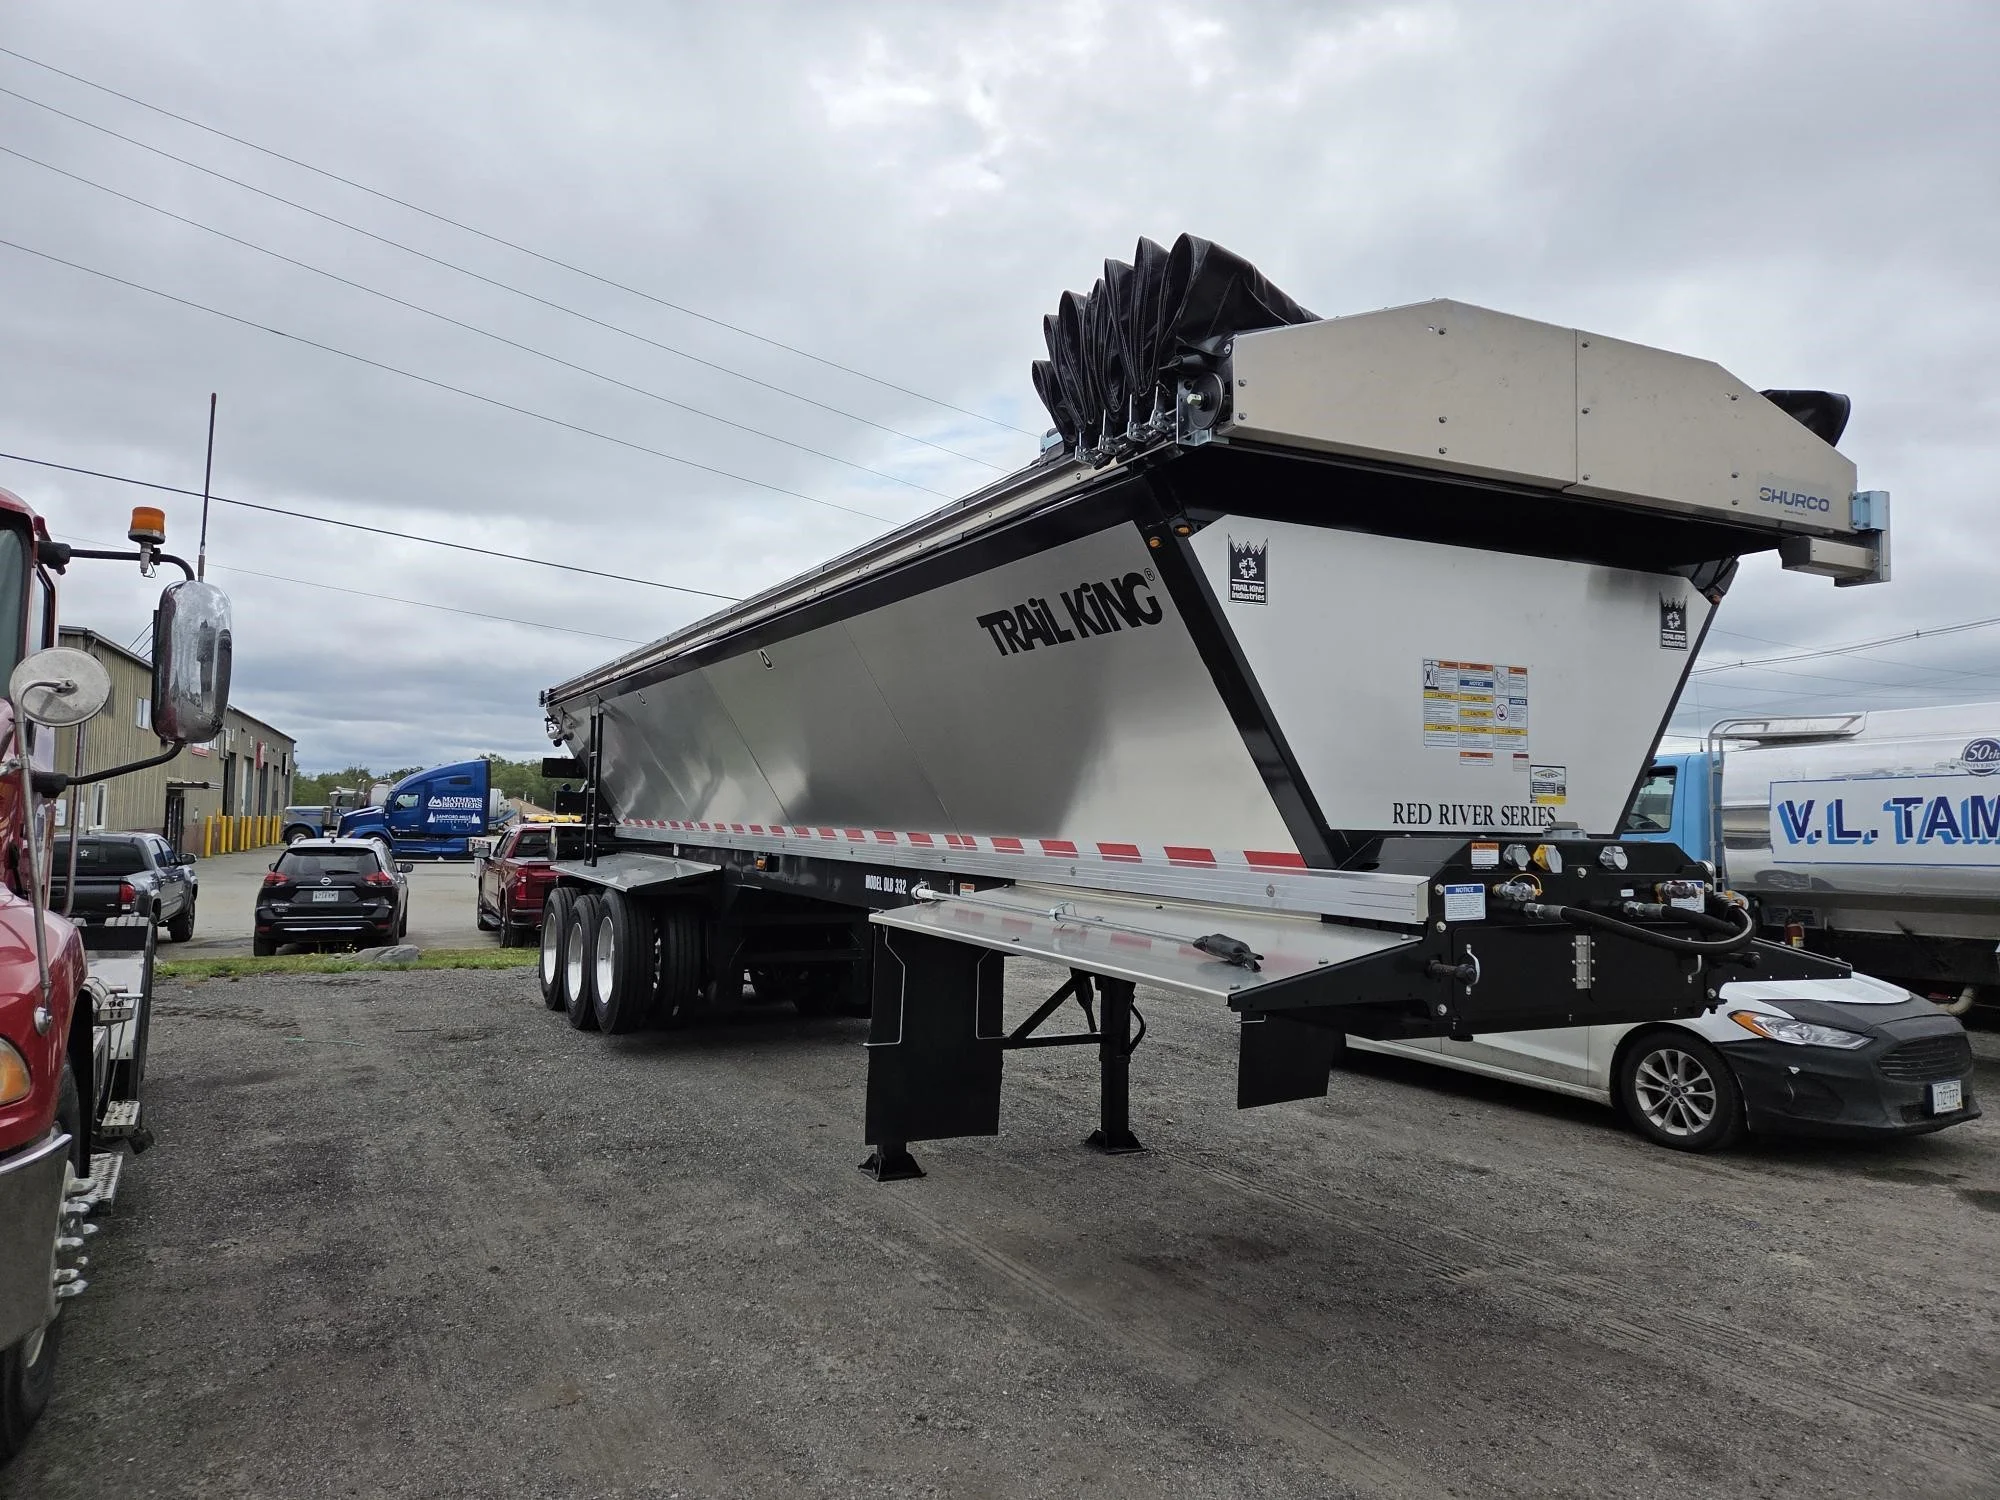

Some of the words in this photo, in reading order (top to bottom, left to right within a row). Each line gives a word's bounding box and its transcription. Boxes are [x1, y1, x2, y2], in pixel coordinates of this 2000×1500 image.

[1759, 487, 1831, 512] SHURCO
[1393, 803, 1432, 824] RED
[1439, 804, 1495, 826] RIVER
[1501, 805, 1556, 827] SERIES
[865, 874, 882, 891] MODEL
[895, 878, 907, 894] 332
